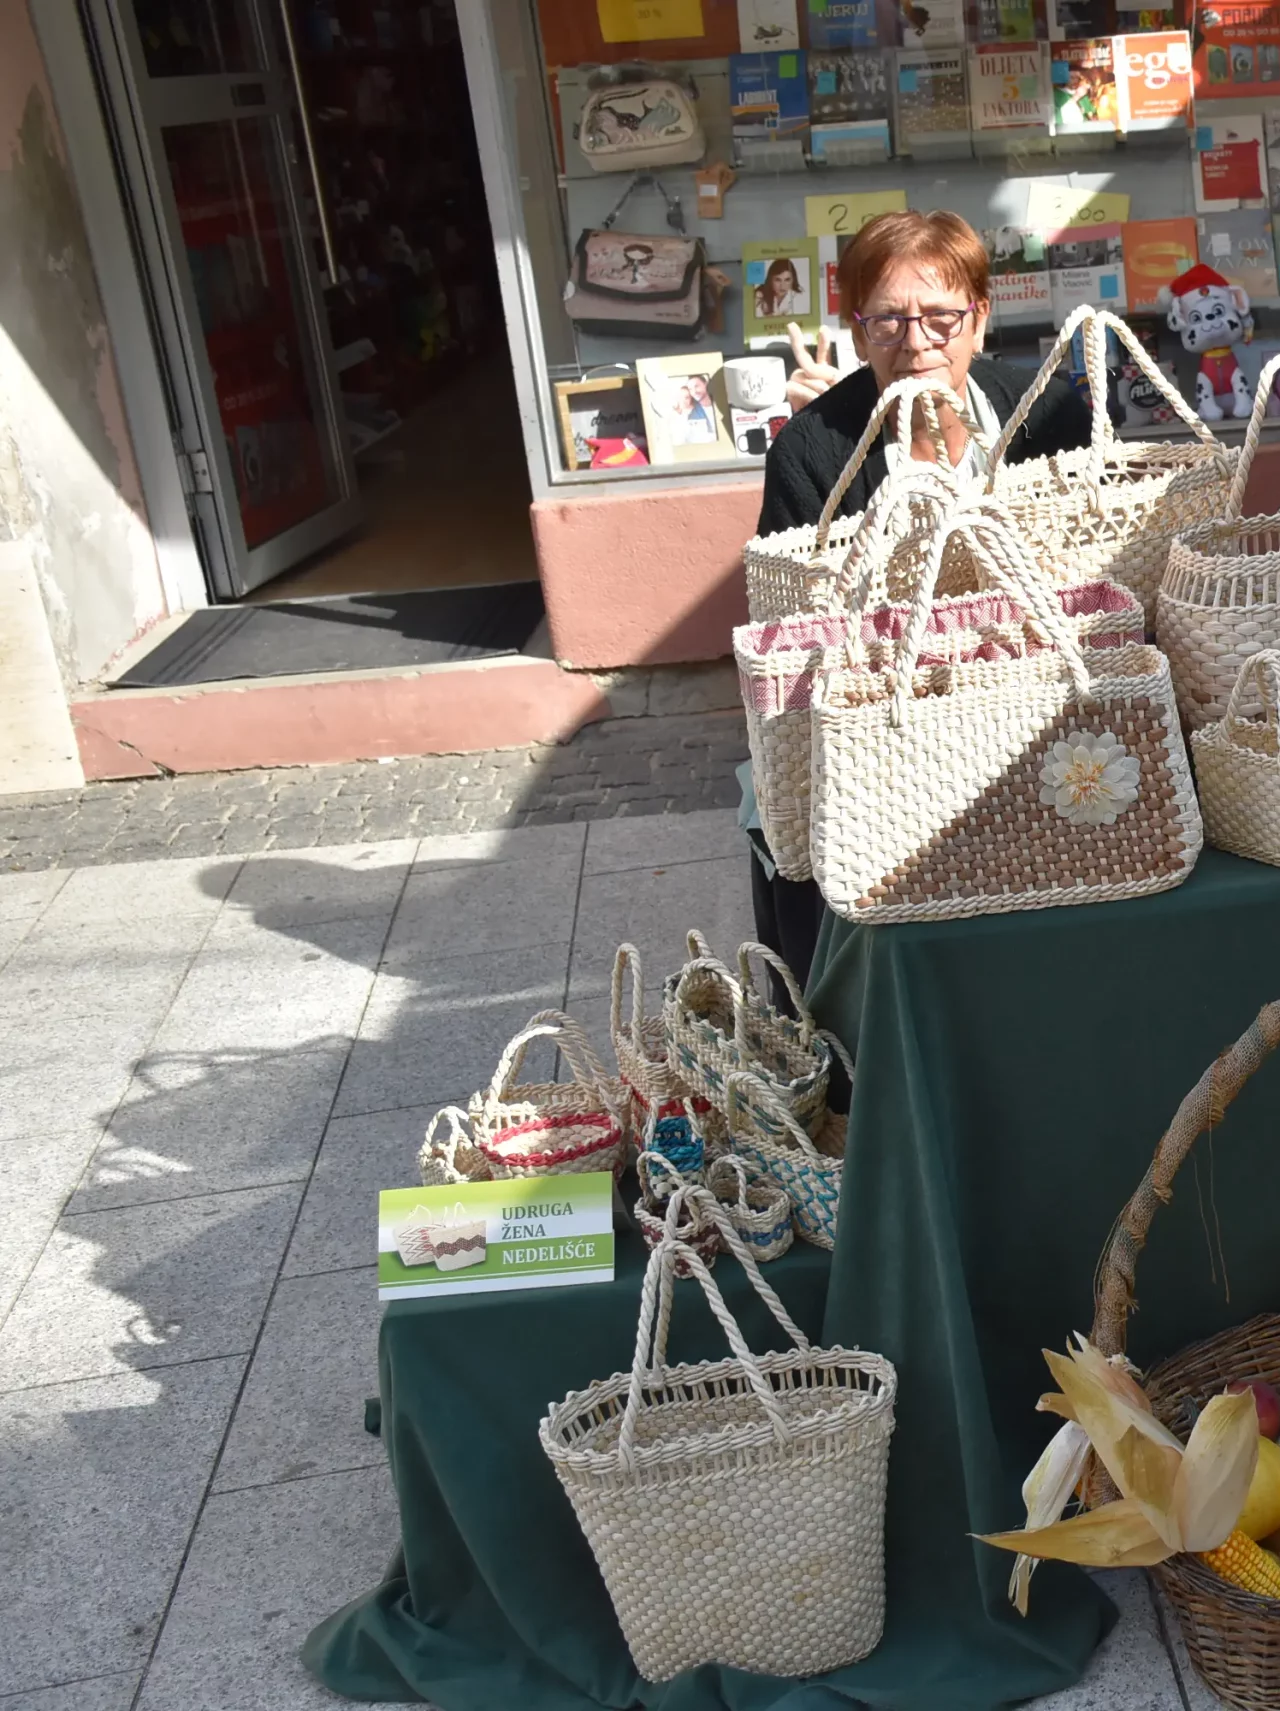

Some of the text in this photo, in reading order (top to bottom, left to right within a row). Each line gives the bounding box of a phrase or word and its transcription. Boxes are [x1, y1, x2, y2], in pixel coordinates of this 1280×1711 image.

[980, 55, 1037, 76] DIJETA
[1002, 76, 1019, 100] 5
[983, 101, 1040, 117] FAKTORA
[502, 1202, 573, 1220] UDRUGA
[502, 1223, 546, 1240] ŽENA
[502, 1240, 595, 1265] NEDELIŠĆE
